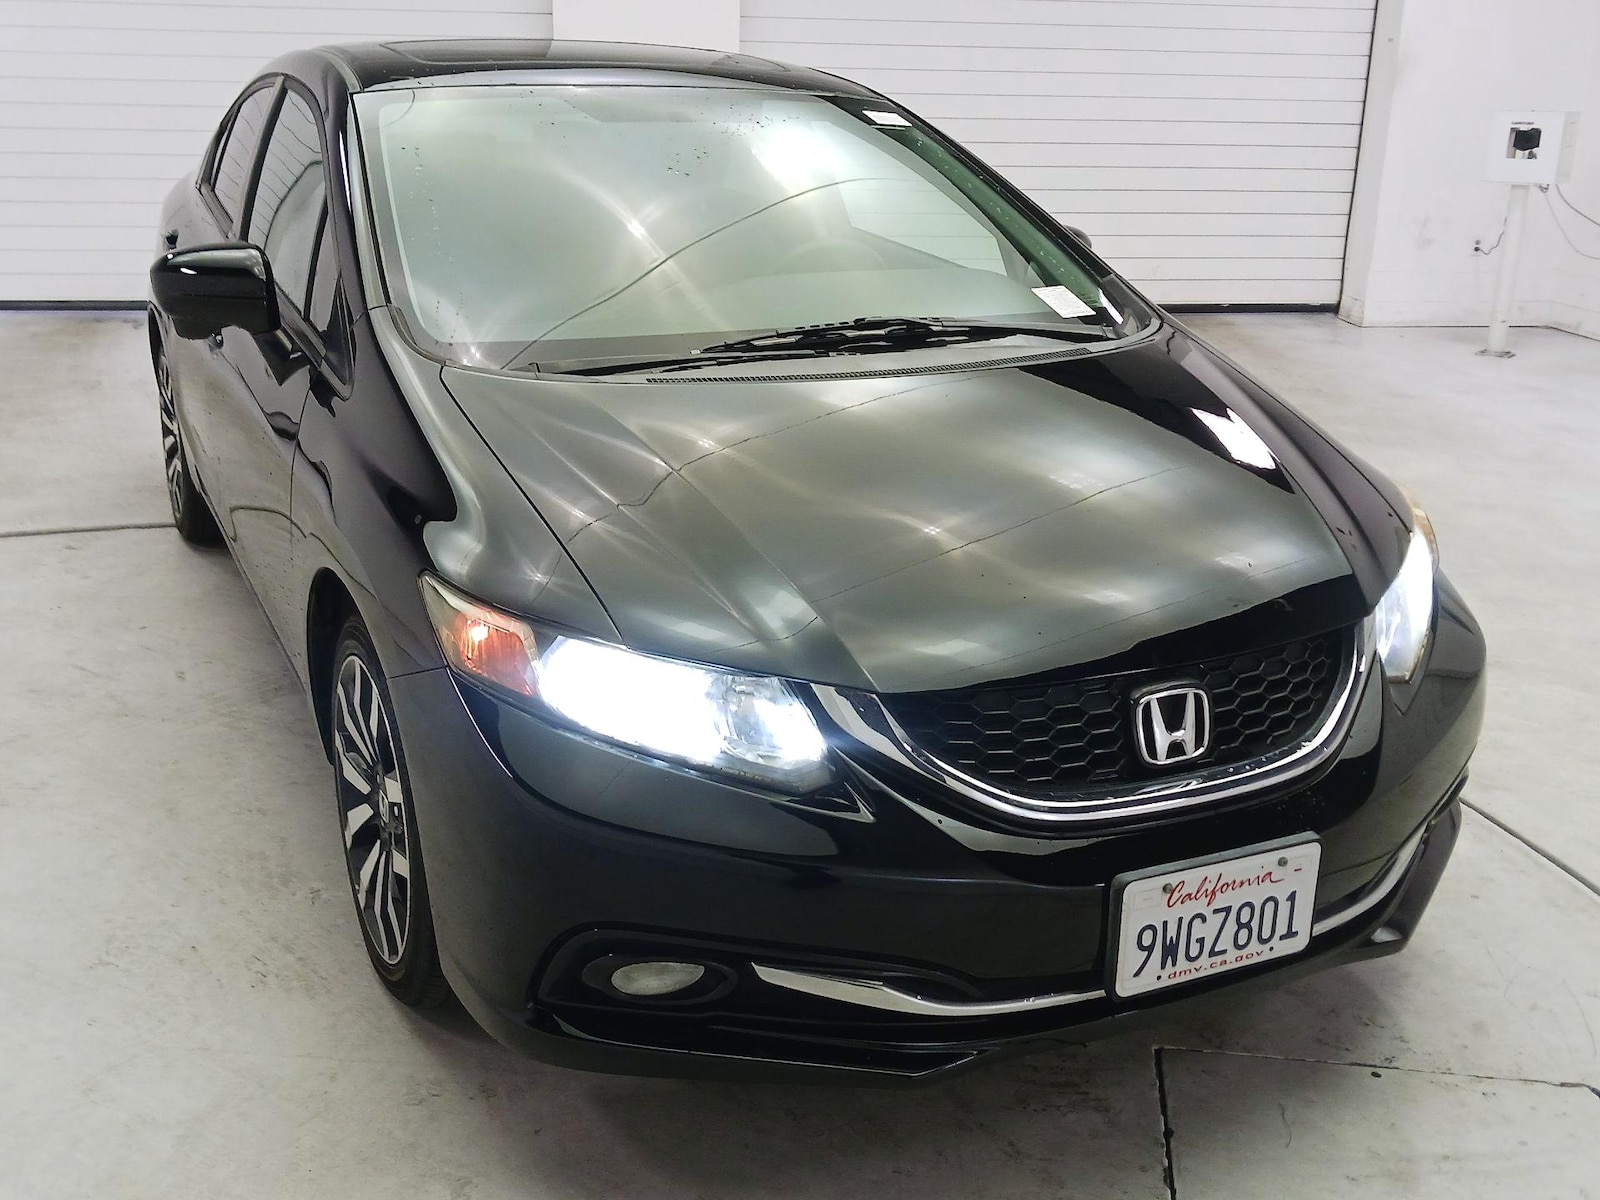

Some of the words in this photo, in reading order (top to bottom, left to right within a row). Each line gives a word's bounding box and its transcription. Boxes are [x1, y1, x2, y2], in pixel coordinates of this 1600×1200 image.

[1167, 871, 1285, 908] California
[1133, 890, 1299, 978] 9WGZ801
[1168, 950, 1264, 980] dmv.ca.gov
